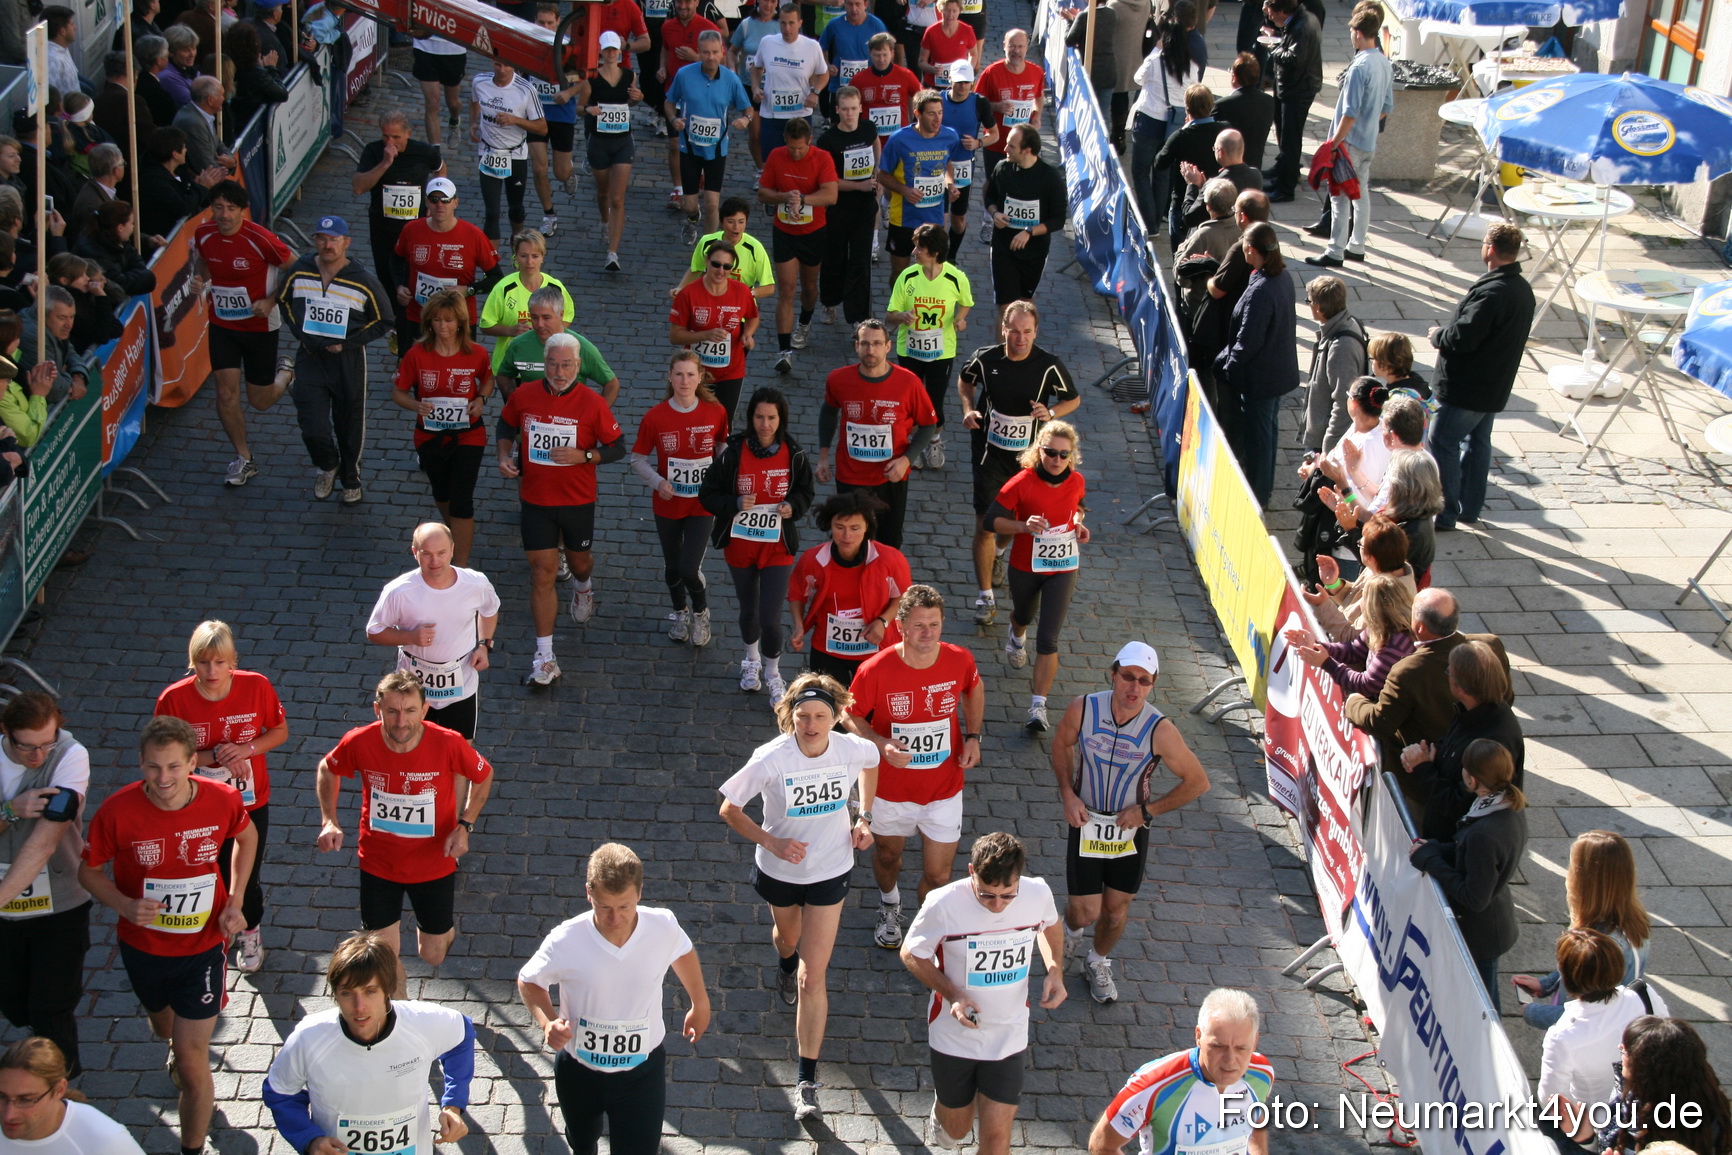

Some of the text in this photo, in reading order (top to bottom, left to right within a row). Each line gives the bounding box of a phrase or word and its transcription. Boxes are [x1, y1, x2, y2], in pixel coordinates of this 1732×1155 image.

[775, 95, 800, 106] 3187
[602, 112, 627, 123] 2993
[871, 114, 897, 127] 2177
[692, 122, 717, 137] 2992
[483, 155, 508, 169] 3093
[851, 155, 870, 170] 293
[918, 183, 943, 197] 2593
[391, 194, 414, 208] 758
[1008, 205, 1036, 220] 2465
[216, 294, 248, 309] 2790
[914, 296, 946, 305] Müller
[310, 305, 343, 325] 3566
[921, 311, 938, 326] M
[909, 336, 938, 351] 3151
[113, 359, 129, 392] einer
[427, 407, 464, 422] 3327
[993, 420, 1028, 439] 2429
[533, 433, 571, 449] 2807
[851, 432, 887, 448] 2187
[853, 448, 886, 457] Dominik
[27, 504, 41, 535] Fun
[738, 511, 778, 529] 2806
[747, 527, 765, 537] Elke
[1038, 541, 1073, 559] 2231
[1041, 558, 1070, 567] Sabine
[832, 625, 863, 643] 267
[835, 641, 870, 651] Claudia
[415, 669, 456, 689] 3401
[892, 704, 910, 713] NEU
[898, 732, 945, 753] 2497
[1083, 735, 1145, 761] CUBE
[911, 752, 939, 764] ubert
[793, 774, 820, 782] PFLEIDERER
[793, 780, 843, 807] 2545
[376, 802, 425, 823] 3471
[798, 803, 836, 816] Andrea
[182, 830, 213, 840] STADTLAUF
[183, 825, 219, 836] NEUMARKTER
[1094, 822, 1123, 841] 101
[137, 843, 160, 851] IMMER
[137, 848, 161, 856] WIEDER
[139, 852, 161, 863] NEU
[154, 883, 187, 891] PFLEIDERER
[160, 891, 202, 914] 477
[159, 913, 200, 927] Tobias
[977, 939, 1007, 947] PFLEIDERER
[974, 945, 1026, 972] 2754
[984, 971, 1018, 984] Oliver
[587, 1021, 619, 1030] PFLEIDERER
[583, 1030, 642, 1055] 3180
[389, 1056, 421, 1071] THORWART
[590, 1052, 632, 1067] Holger
[350, 1119, 386, 1127] PFLEIDERER
[346, 1124, 410, 1152] 2654
